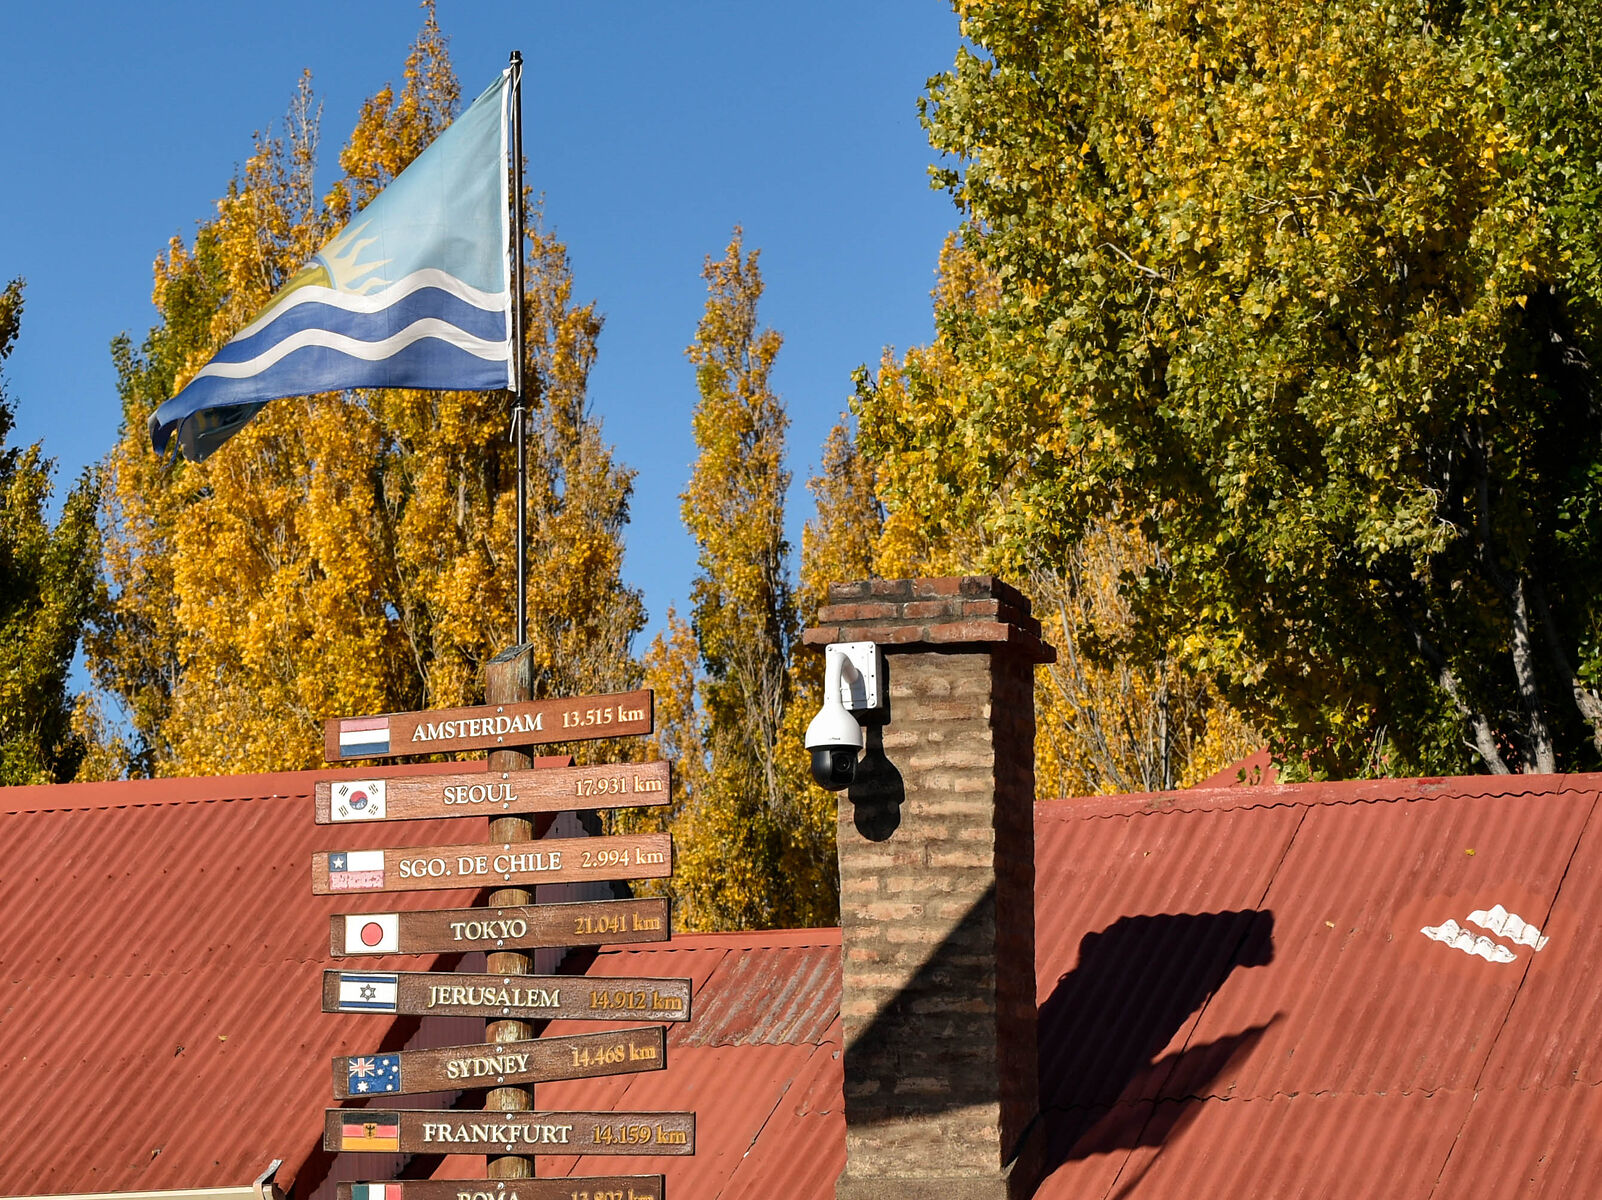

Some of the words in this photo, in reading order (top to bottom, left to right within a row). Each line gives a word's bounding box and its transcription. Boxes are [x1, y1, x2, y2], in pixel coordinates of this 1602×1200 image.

[412, 712, 543, 742] AMSTERDAM
[562, 709, 613, 728] 13.515
[618, 706, 644, 723] km
[443, 784, 518, 804] SEOUL
[575, 777, 626, 796] 17.931
[634, 776, 662, 793] km
[399, 856, 451, 878] SGO.
[458, 857, 489, 875] DE
[493, 852, 562, 873] CHILE
[581, 850, 629, 868] 2.994
[636, 848, 664, 864] km
[451, 920, 526, 940] TOKYO
[574, 916, 626, 934] 21.041
[632, 914, 659, 931] km
[428, 987, 559, 1007] JERUSALEM
[590, 991, 645, 1009] 14.912
[652, 991, 682, 1010] km
[448, 1054, 529, 1079] SYDNEY
[572, 1044, 624, 1067] 14.468
[629, 1043, 656, 1061] km
[423, 1124, 572, 1144] FRANKFURT
[593, 1126, 651, 1144] 14.159
[656, 1126, 686, 1144] km
